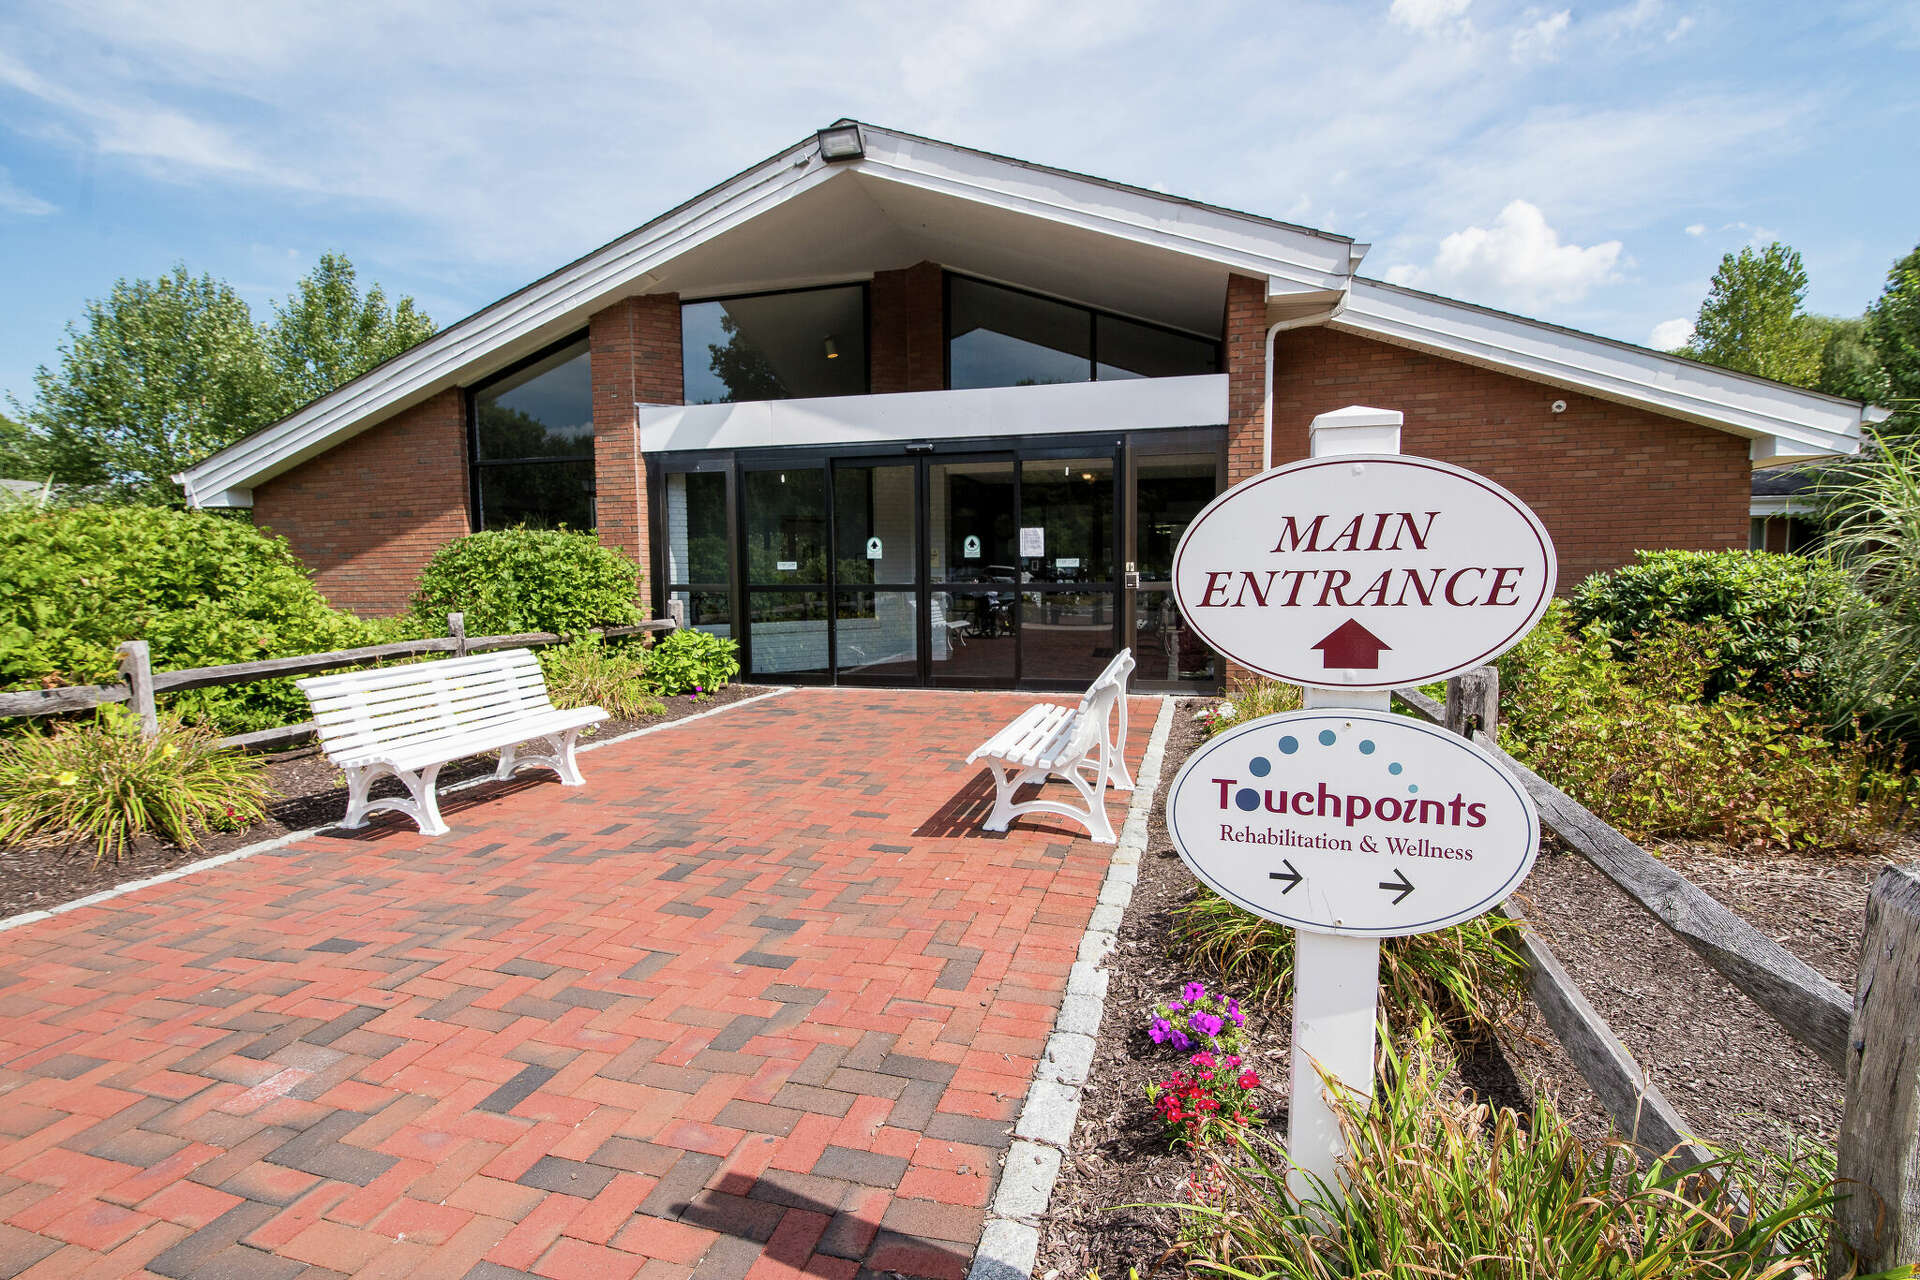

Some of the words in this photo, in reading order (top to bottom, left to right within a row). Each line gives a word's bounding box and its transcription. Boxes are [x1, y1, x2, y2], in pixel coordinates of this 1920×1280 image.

[1270, 512, 1441, 553] MAIN
[1196, 567, 1524, 608] ENTRANCE
[1211, 778, 1487, 828] Touchpoints
[1219, 824, 1353, 852] Rehabilitation
[1359, 835, 1379, 854] &
[1384, 836, 1473, 861] Wellness
